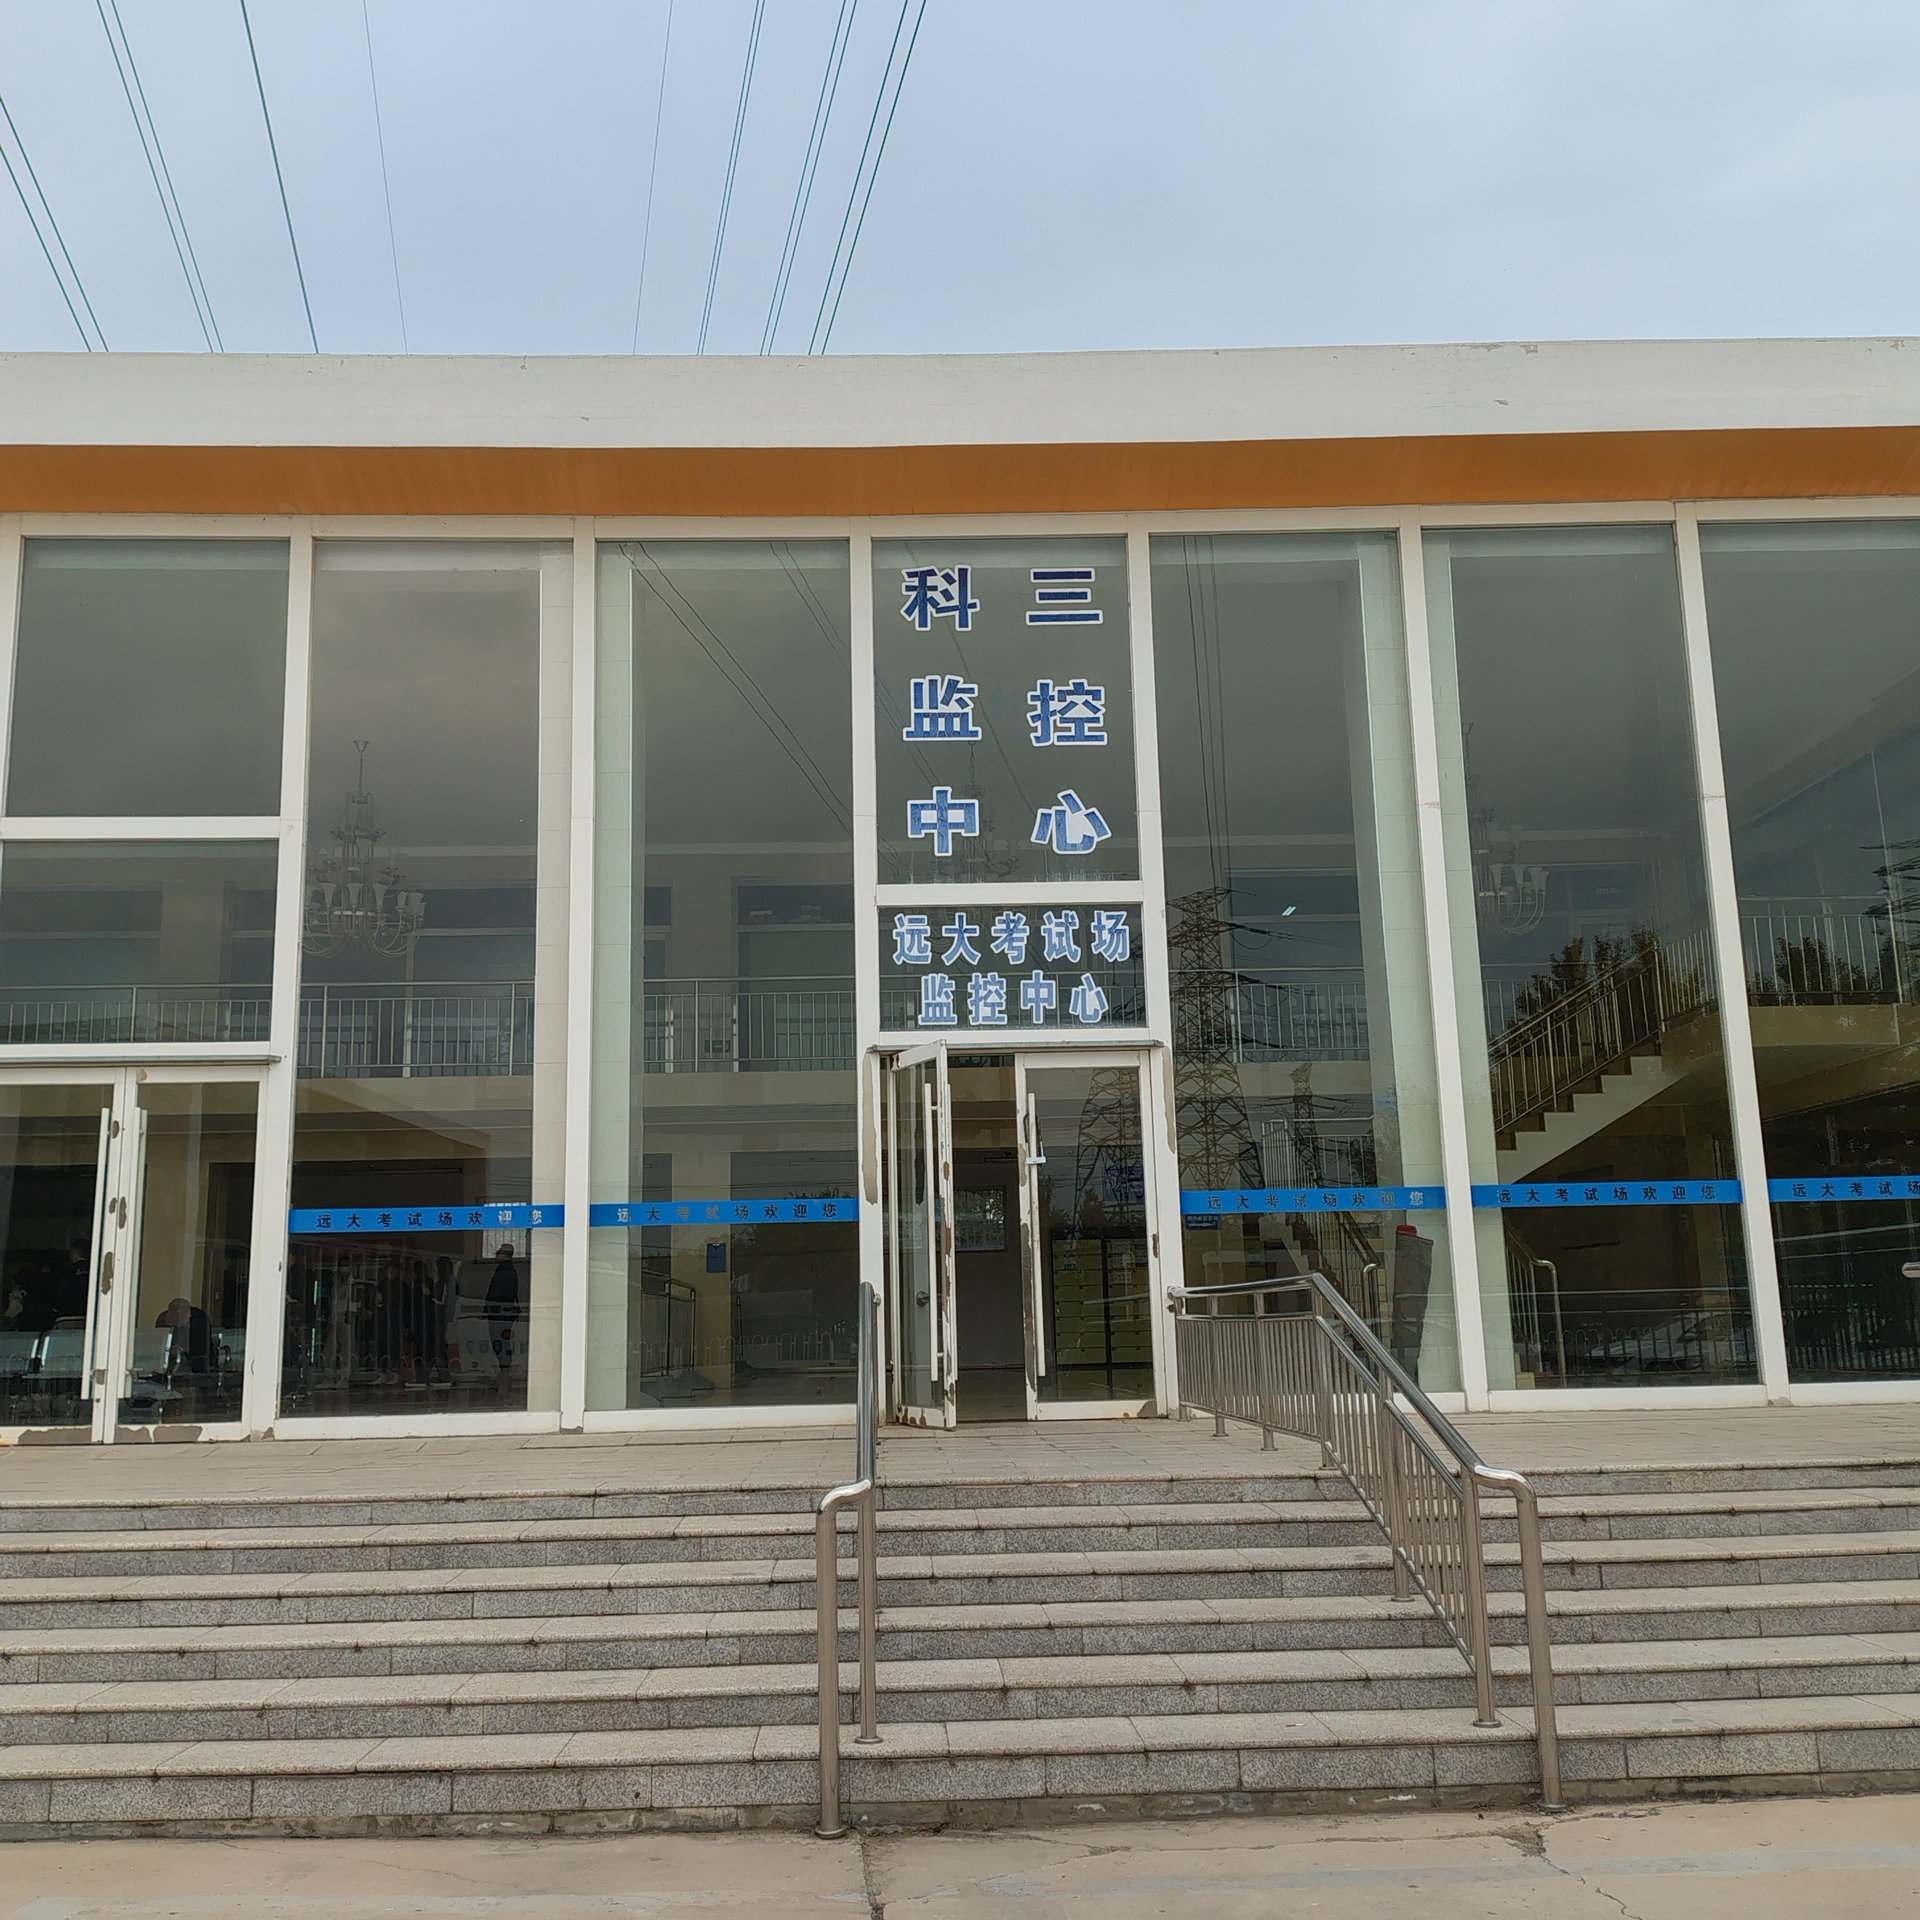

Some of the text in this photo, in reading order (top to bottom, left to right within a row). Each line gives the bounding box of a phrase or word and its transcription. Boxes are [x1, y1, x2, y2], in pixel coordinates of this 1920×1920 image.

[900, 565, 1103, 631] 科三
[903, 675, 1107, 746] 监控
[907, 786, 1112, 856] 中心
[892, 910, 1131, 965] 远大考试场
[918, 970, 1108, 1025] 监控中心
[1207, 1191, 1424, 1210] 远大考试场欢迎您
[1497, 1185, 1717, 1203] 远大考试场欢迎您
[1792, 1180, 1920, 1197] 远大考试场
[316, 1209, 543, 1228] 远大考试场欢迎您
[617, 1203, 837, 1223] 远大考试场欢迎您
